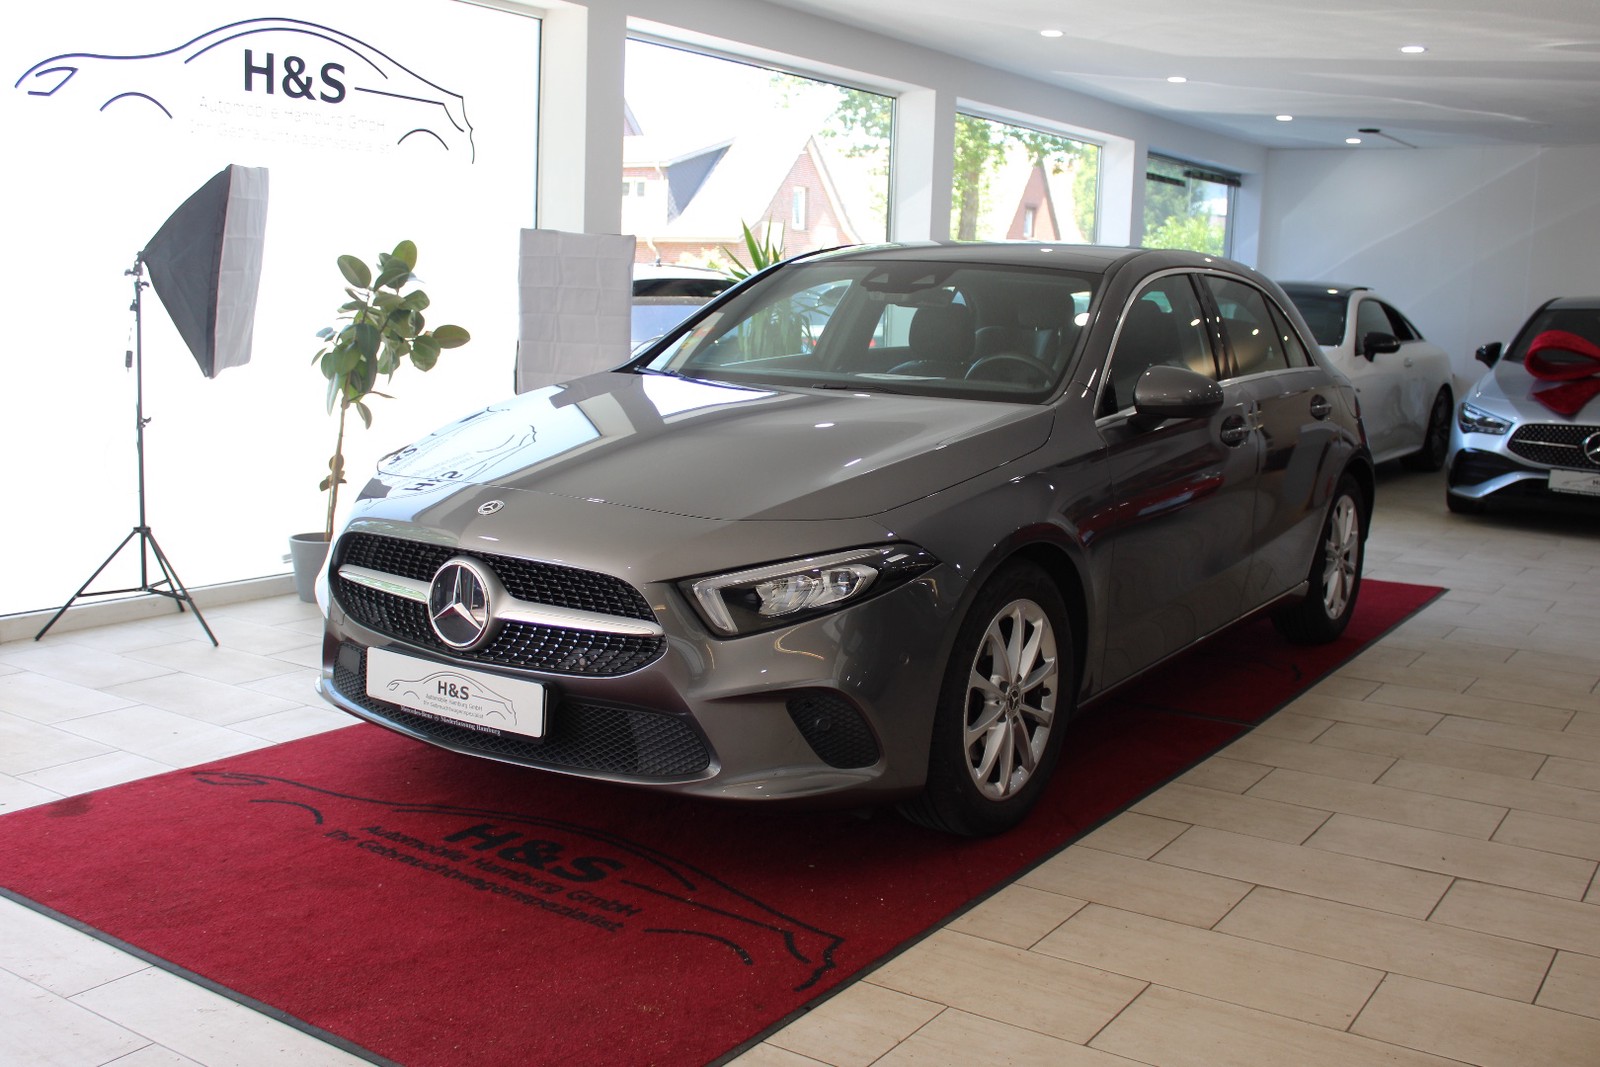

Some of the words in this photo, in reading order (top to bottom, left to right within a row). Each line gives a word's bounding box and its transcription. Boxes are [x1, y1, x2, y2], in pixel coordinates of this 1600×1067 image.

[245, 49, 346, 104] H&S
[437, 680, 470, 700] H&S
[476, 724, 501, 736] Hamburg
[360, 826, 469, 862] Automobile
[467, 858, 566, 894] Hamburg
[566, 890, 643, 917] GmbH
[443, 823, 627, 883] H&S
